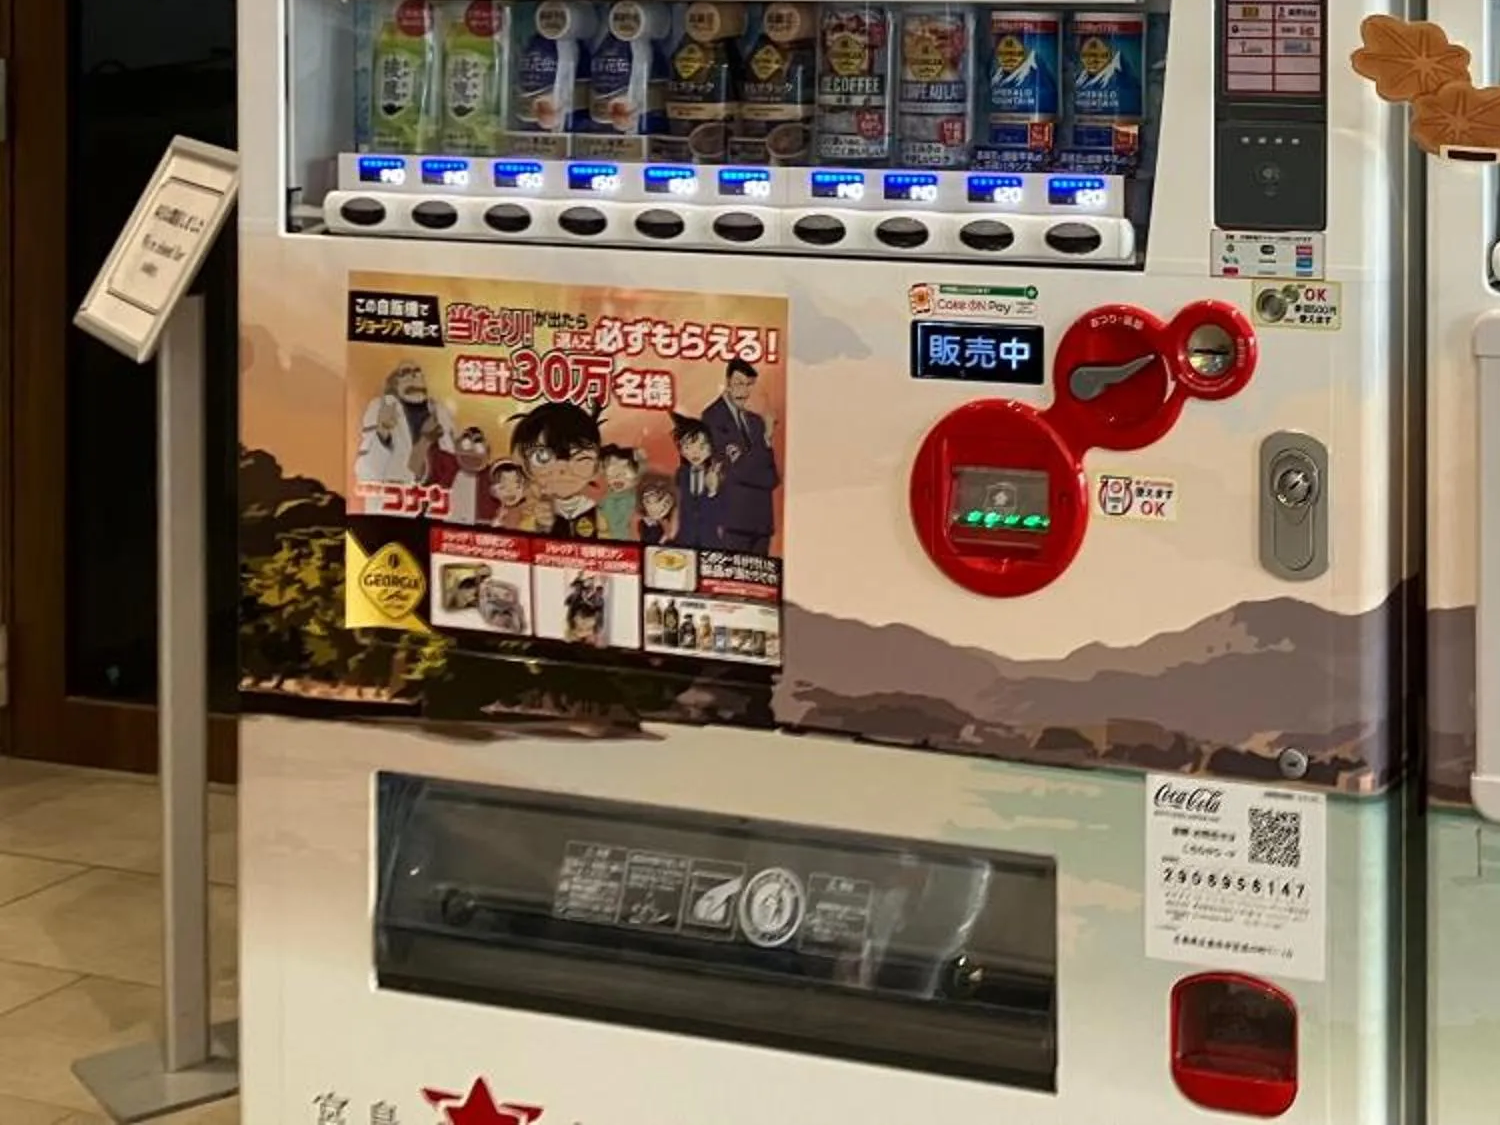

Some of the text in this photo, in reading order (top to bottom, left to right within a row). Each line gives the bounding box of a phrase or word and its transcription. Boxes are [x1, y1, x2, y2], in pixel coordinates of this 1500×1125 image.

[1303, 287, 1328, 302] OK
[355, 298, 430, 318] この自販機で
[989, 301, 1012, 316] Pay
[595, 316, 780, 364] 必ずもらえる!
[928, 334, 1031, 371] 販売中
[1140, 501, 1166, 517] OK
